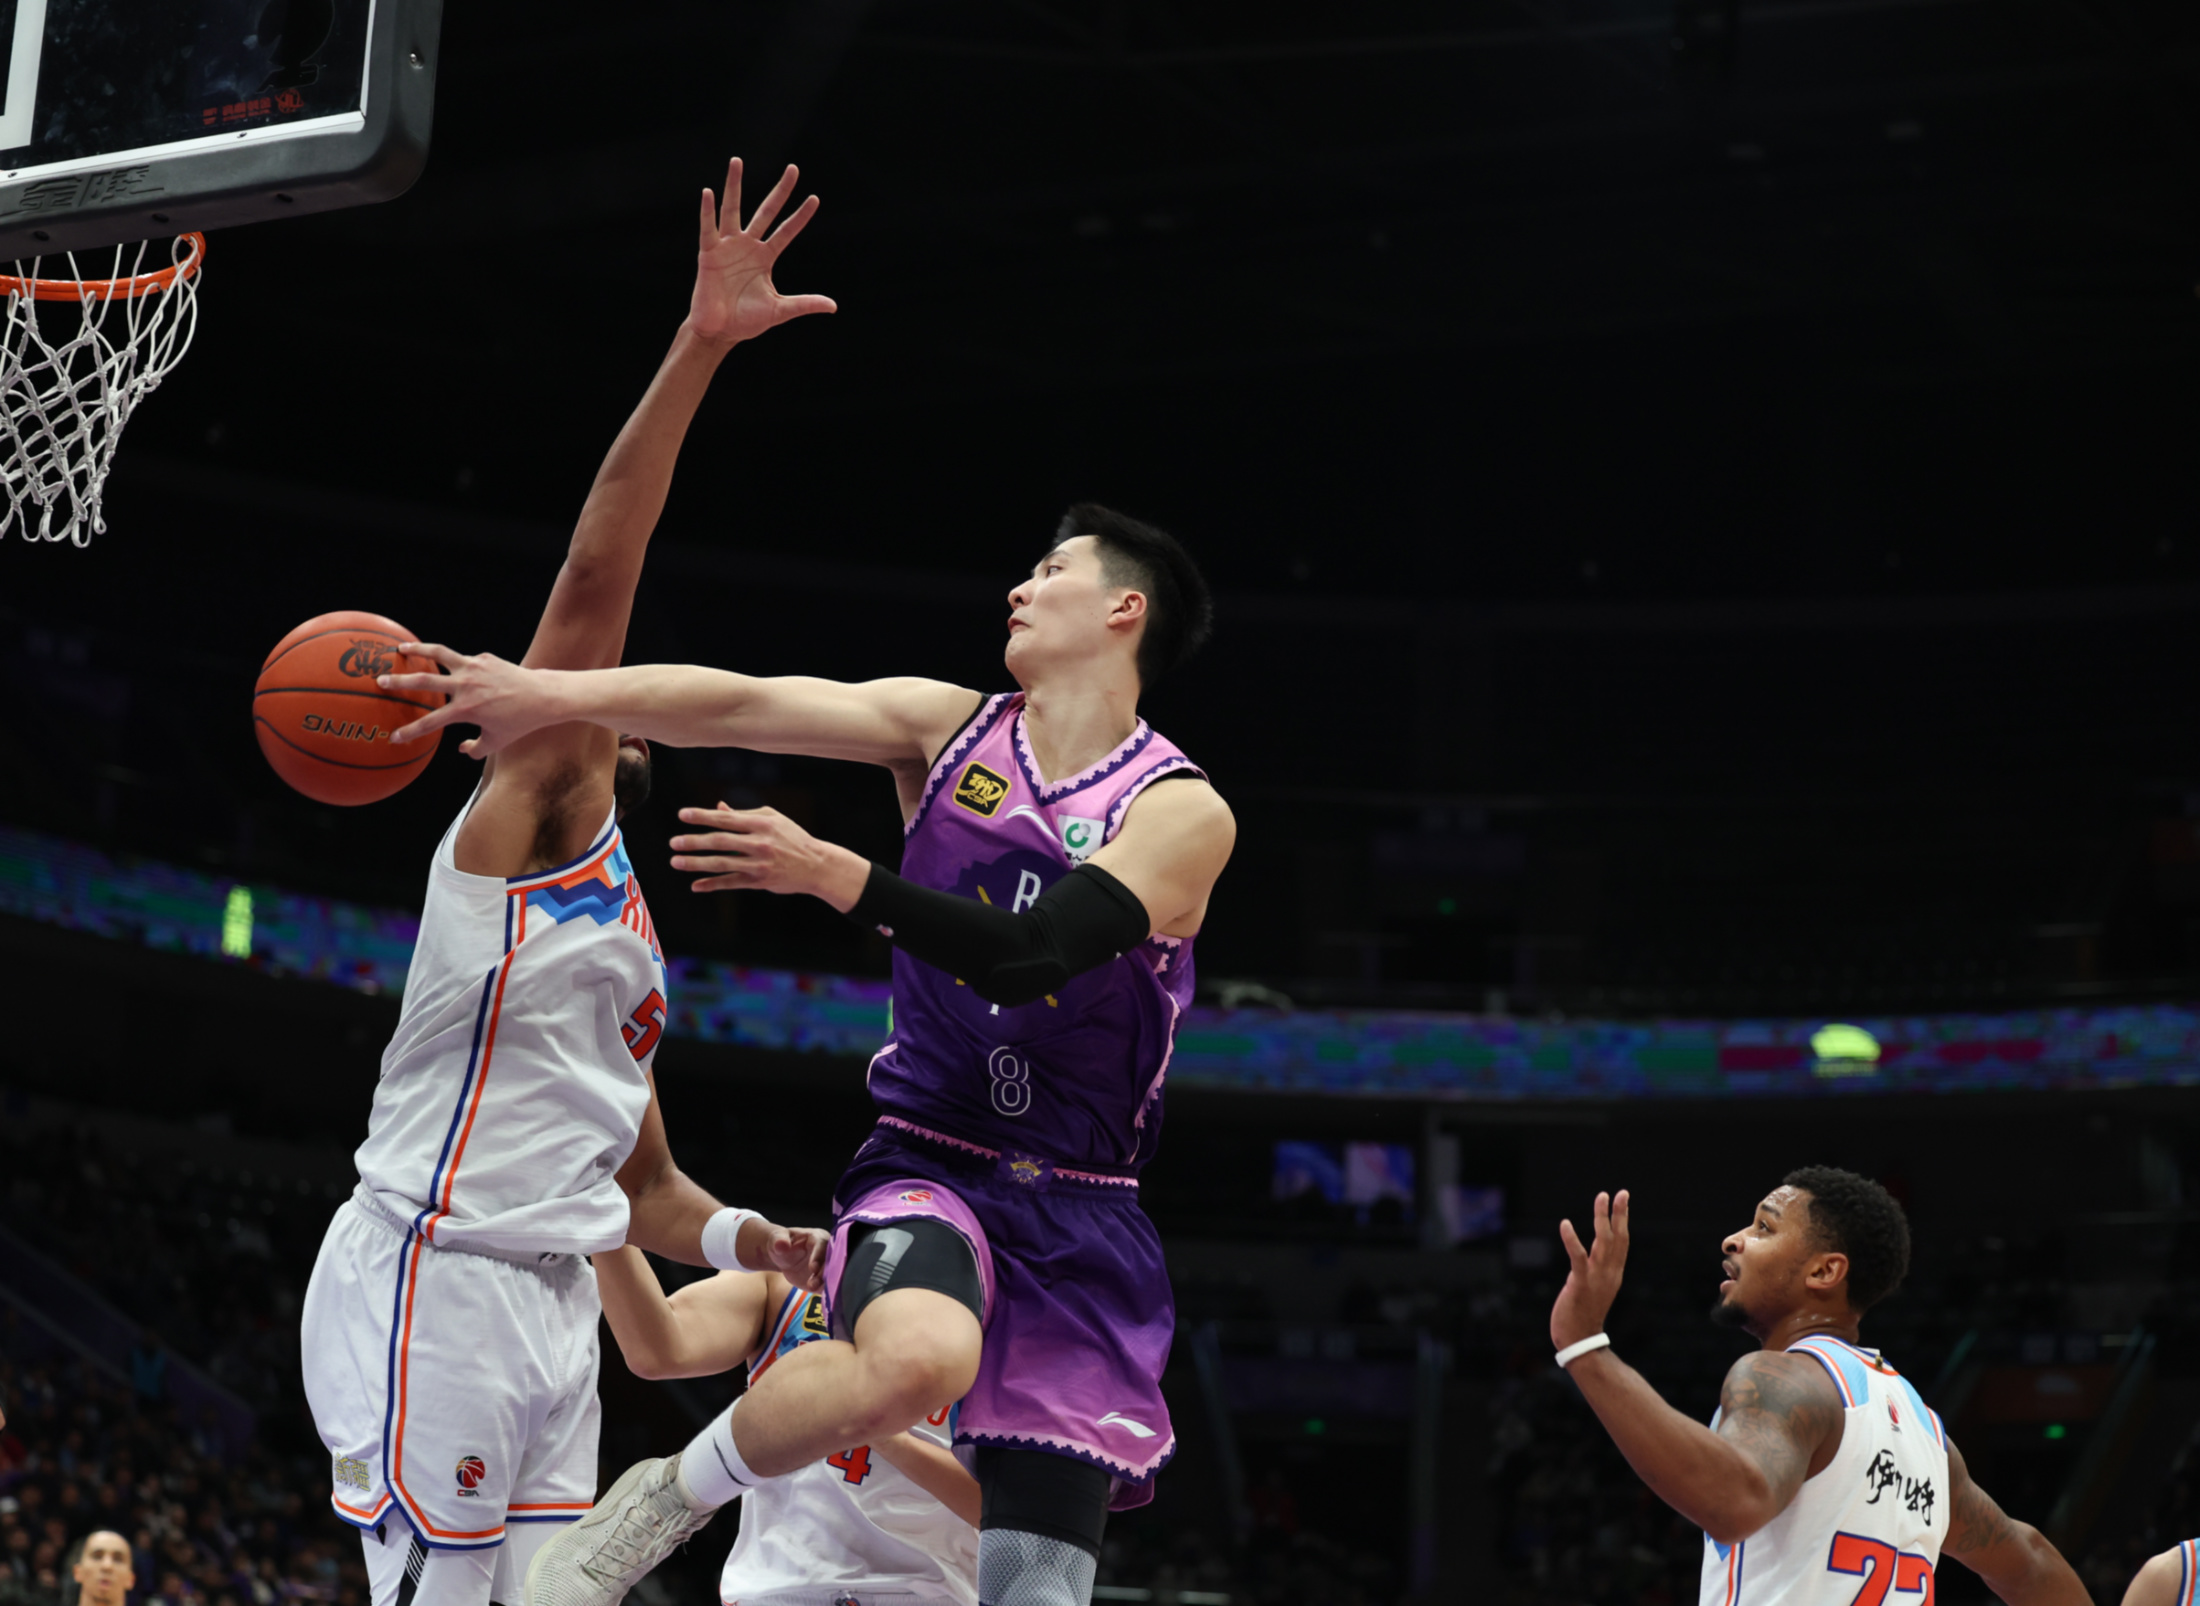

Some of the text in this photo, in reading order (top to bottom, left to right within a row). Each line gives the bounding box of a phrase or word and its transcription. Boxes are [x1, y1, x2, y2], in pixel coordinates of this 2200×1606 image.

[620, 987, 667, 1062] 5
[989, 1045, 1031, 1117] 8
[457, 1489, 479, 1497] CBA
[826, 1444, 872, 1486] 4
